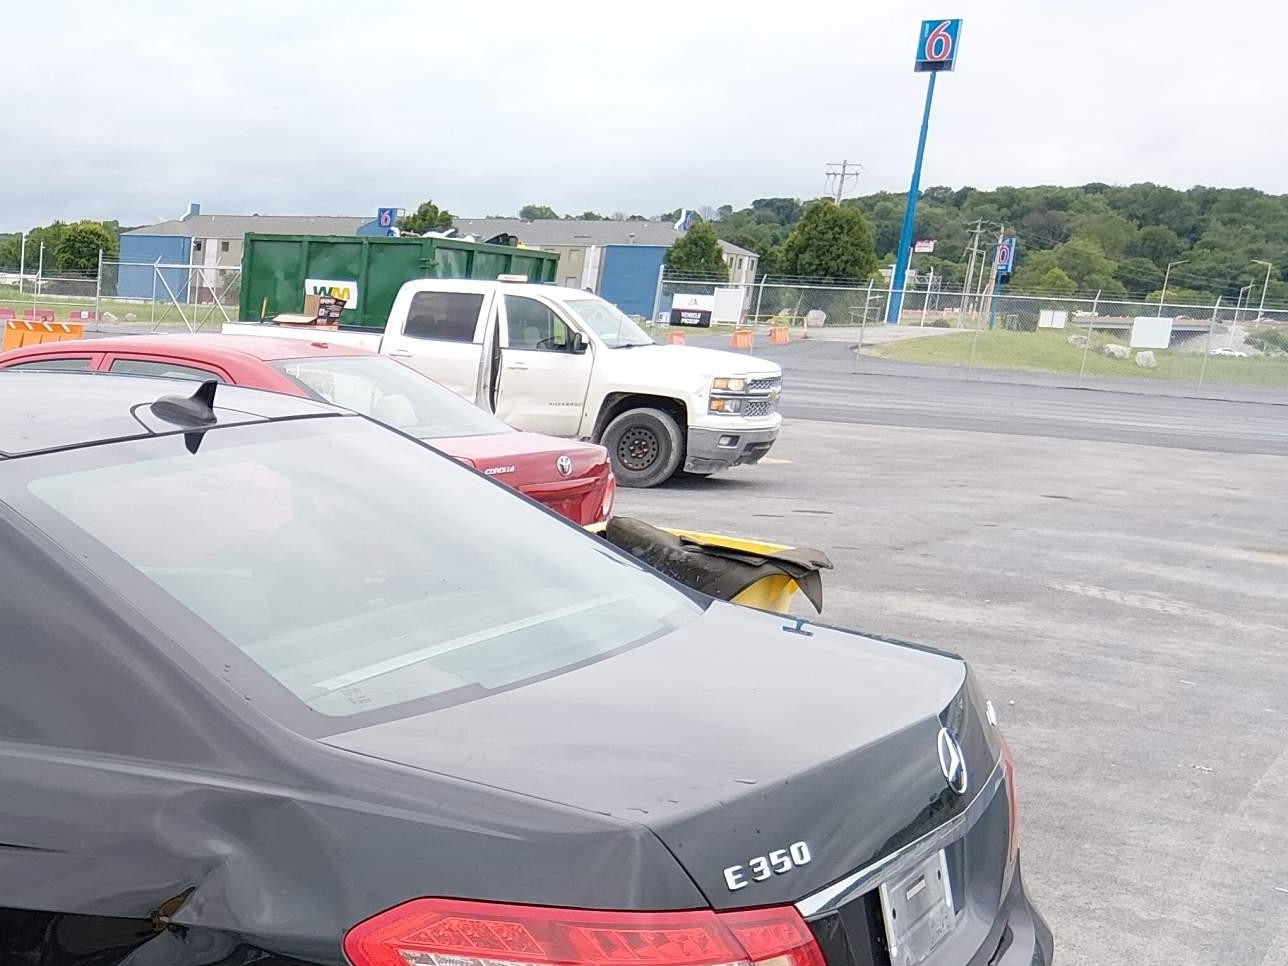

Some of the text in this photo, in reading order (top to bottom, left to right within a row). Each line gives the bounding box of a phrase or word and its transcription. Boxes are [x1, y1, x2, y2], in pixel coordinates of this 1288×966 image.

[925, 20, 952, 61] 6
[380, 210, 391, 226] 6
[313, 286, 351, 301] WM
[484, 466, 515, 475] COROLLA
[723, 841, 811, 891] E 350
